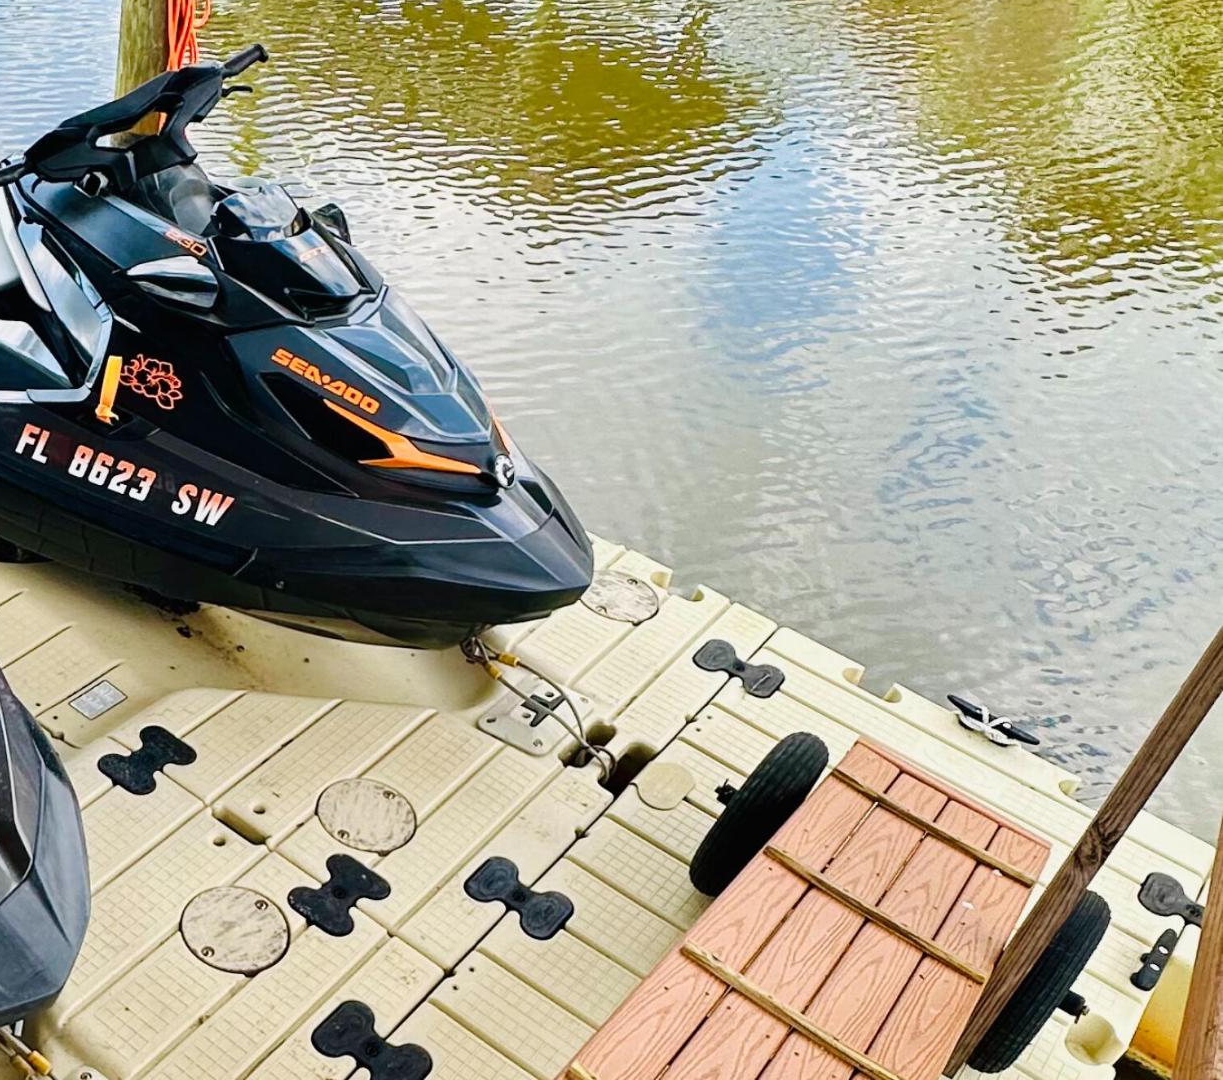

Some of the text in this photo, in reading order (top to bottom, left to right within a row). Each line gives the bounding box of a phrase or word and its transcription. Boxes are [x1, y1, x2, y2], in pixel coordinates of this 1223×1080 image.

[14, 423, 235, 527] FL 8623 SW
